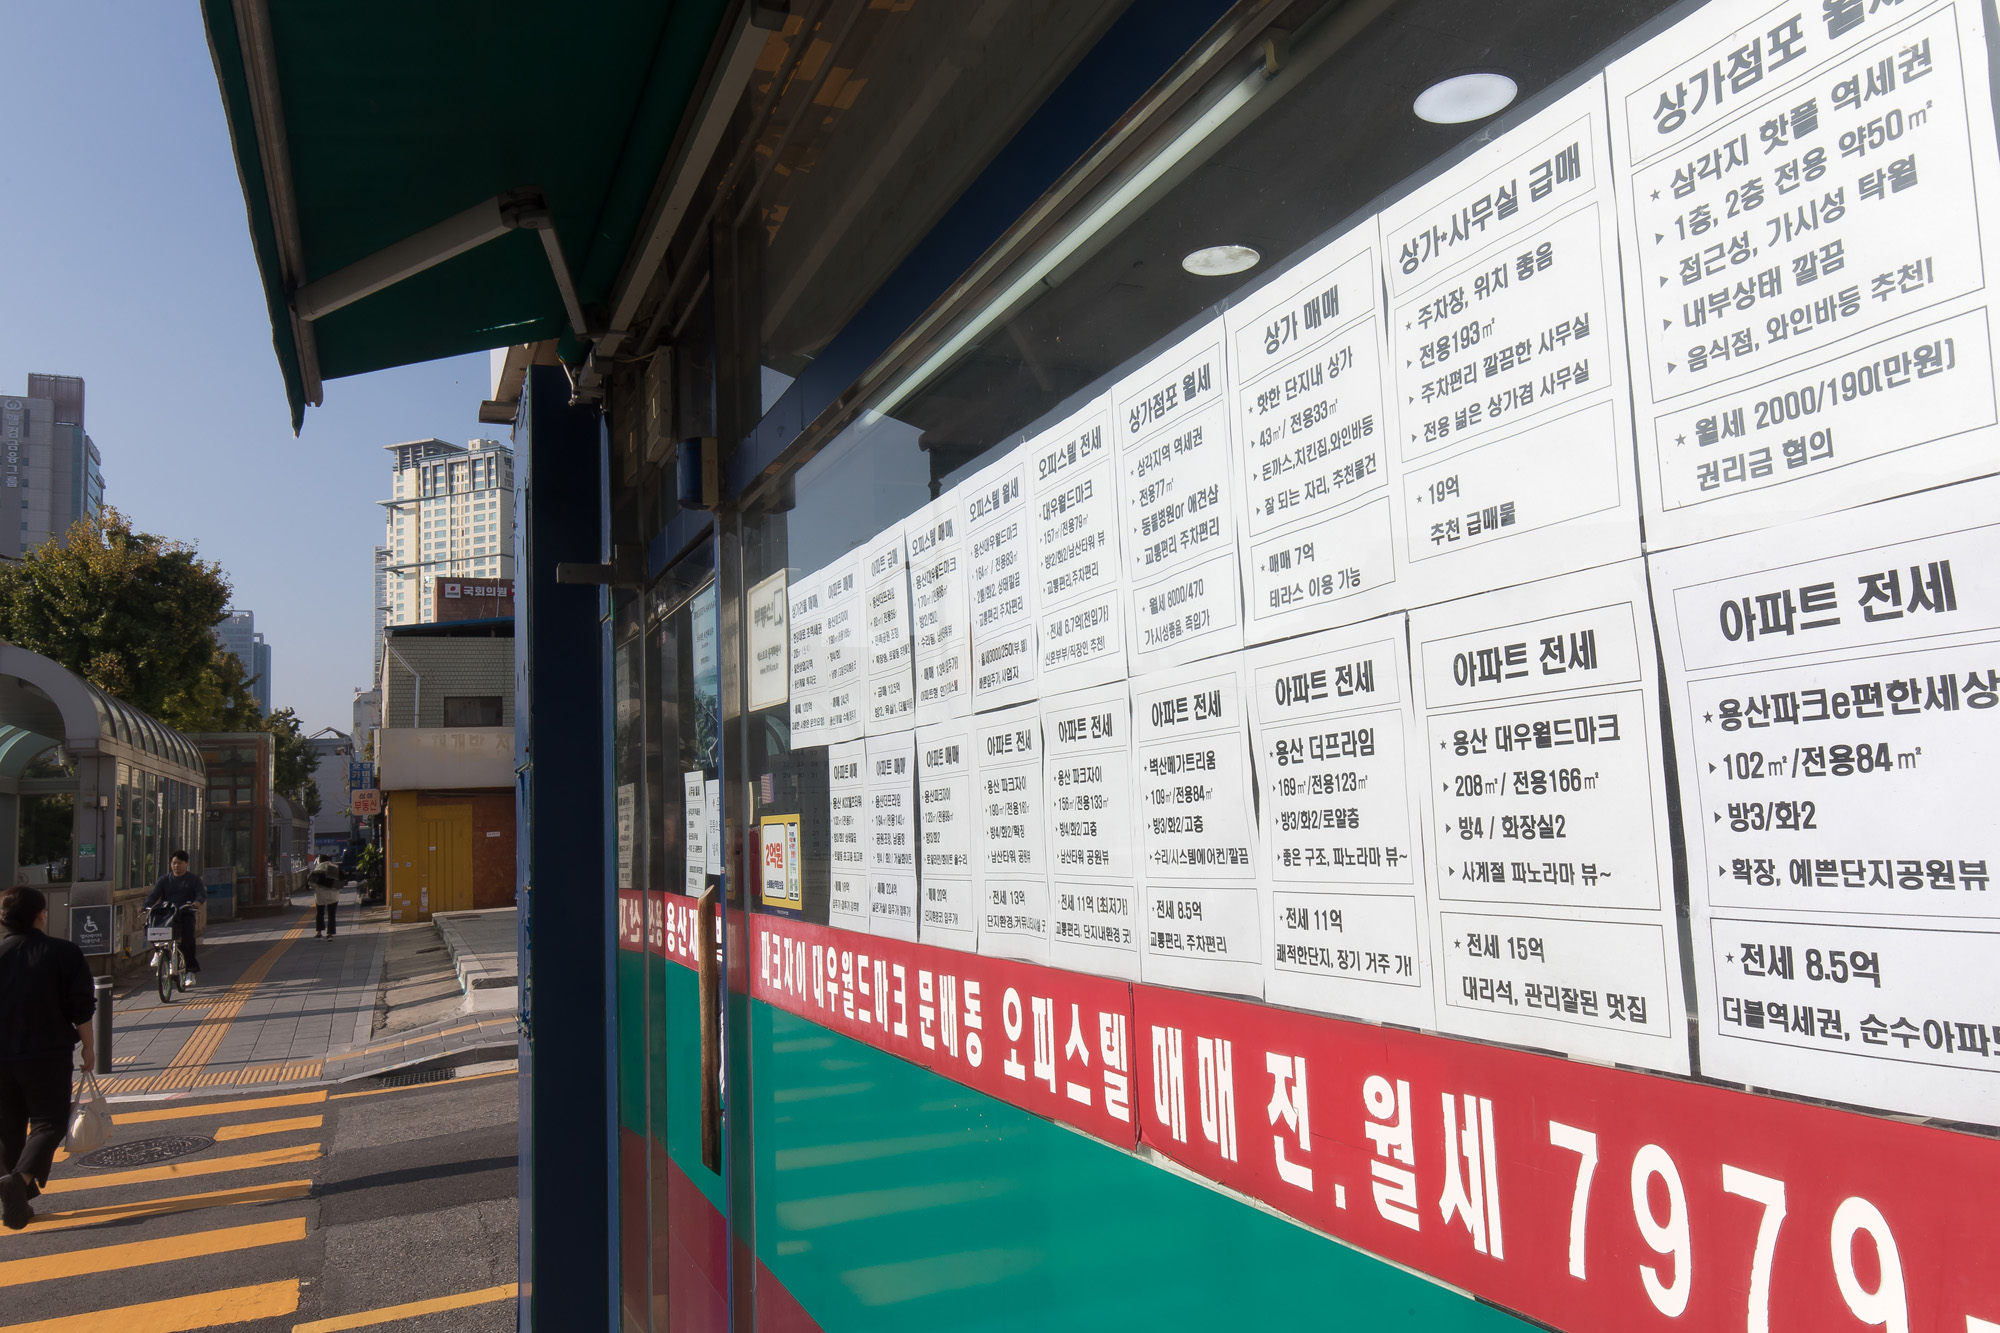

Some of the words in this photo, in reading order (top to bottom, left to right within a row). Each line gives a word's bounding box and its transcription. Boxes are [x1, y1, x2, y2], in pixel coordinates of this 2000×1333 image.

[1652, 12, 1806, 134] 상가점포
[1822, 0, 1904, 40] 월
[1670, 132, 1749, 200] 삼각지
[1759, 97, 1818, 155] 핫플
[1831, 37, 1932, 111] 역세권
[1528, 141, 1581, 202] 급매
[1674, 202, 1718, 241] 1층,
[1725, 176, 1764, 219] 2층
[1774, 146, 1827, 196] 전용
[1679, 230, 1758, 286] 접근성,
[1766, 186, 1846, 248] 가시성
[1858, 153, 1918, 201] 탁월
[1417, 286, 1468, 330] 주차장,
[1474, 262, 1508, 301] 위치
[1516, 241, 1553, 281] 좋음
[1682, 265, 1782, 327] 내부상태
[1792, 238, 1845, 286] 깔끔
[1263, 310, 1298, 355] 상가
[1303, 284, 1339, 330] 매매
[1687, 326, 1760, 373] 음식점,
[1766, 284, 1861, 344] 와인바등
[1871, 256, 1933, 302] 추천!
[1421, 361, 1477, 404] 주차편리
[1482, 338, 1532, 378] 깔끔한
[1538, 312, 1590, 355] 사무실
[1128, 382, 1178, 434] 상가점포
[1182, 362, 1211, 402] 월세
[1257, 384, 1281, 416] 핫한
[1284, 362, 1323, 401] 단지내
[1327, 345, 1353, 379] 상가
[1423, 415, 1450, 443] 전용
[1454, 402, 1482, 431] 넓은
[1487, 380, 1534, 418] 상가겸
[1539, 358, 1589, 397] 사무실
[1695, 407, 1746, 447] 월세
[1038, 439, 1077, 481] 오피스텔
[1079, 424, 1102, 458] 전세
[1136, 442, 1171, 478] 삼각지역
[1173, 425, 1203, 455] 역세권
[1696, 446, 1773, 492] 권리금
[1782, 427, 1834, 470] 협의
[969, 488, 1000, 523] 오피스텔
[1002, 476, 1019, 505] 월세
[1042, 479, 1093, 521] 대우월드마크
[1264, 495, 1275, 516] 잘
[1277, 488, 1300, 510] 되는
[1304, 475, 1330, 500] 자리,
[1332, 452, 1376, 489] 추천물건
[1428, 474, 1460, 505] 19억
[1141, 502, 1184, 536] 동물병원or
[1187, 483, 1219, 513] 애견샵
[1430, 517, 1460, 546] 추천
[1466, 501, 1515, 536] 급매물
[1097, 530, 1105, 546] 뷰
[1144, 534, 1177, 565] 교통편리
[1179, 516, 1220, 549] 주차편리
[1268, 549, 1291, 573] 매매
[1294, 542, 1314, 565] 7억
[463, 586, 508, 597] 국회의원
[1149, 593, 1166, 615] 월세
[1167, 578, 1204, 608] 8000/470
[1269, 582, 1304, 608] 테라스
[1308, 574, 1333, 597] 이용
[1337, 566, 1361, 590] 가능
[1719, 581, 1840, 642] 아파트
[1857, 559, 1957, 623] 전세
[1049, 620, 1062, 640] 전세
[1453, 642, 1529, 687] 아파트
[1539, 629, 1598, 676] 전세
[1275, 669, 1328, 706] 아파트
[1334, 659, 1375, 697] 전세
[1718, 669, 2000, 732] 용산파크e편한세상
[1058, 717, 1087, 743] 아파트
[1090, 712, 1113, 739] 전세
[1151, 696, 1189, 728] 아파트
[1193, 689, 1222, 721] 전세
[986, 733, 1013, 756] 아파트
[1015, 728, 1032, 752] 전세
[1275, 737, 1304, 766] 용산
[1308, 727, 1375, 761] 더프라임
[1453, 727, 1488, 756] 용산
[1494, 713, 1620, 752] 대우월드마크
[1057, 768, 1071, 786] 용산
[1072, 765, 1102, 784] 파크자이
[1149, 750, 1216, 776] 벽산메가트리움
[354, 800, 377, 812] 부동산
[1152, 814, 1204, 835] 방3/화2/고층
[1280, 807, 1359, 831] 방3/화2/로얄층
[1458, 816, 1484, 840] 방4
[1501, 814, 1566, 840] 화장실2
[1727, 800, 1817, 832] 방3/화2
[766, 842, 783, 869] 2억원
[1060, 849, 1084, 864] 남산타워
[1086, 849, 1109, 865] 공원뷰
[1154, 847, 1249, 865] 수리/시스템에어컨/깔끔
[1282, 847, 1301, 867] 좋은
[1304, 848, 1330, 867] 구조,
[1332, 846, 1381, 867] 파노라마
[1461, 861, 1506, 883] 사계절
[1510, 861, 1575, 885] 파노라마
[1731, 858, 1781, 886] 확장,
[1789, 858, 1990, 891] 예쁜단지공원뷰
[1060, 893, 1075, 911] 전세
[1076, 895, 1094, 913] 11억
[1156, 899, 1174, 919] 전세
[1177, 901, 1202, 921] 8.5억
[1285, 907, 1309, 930] 전세
[1313, 909, 1343, 933] 11억
[1083, 924, 1120, 943] 단지내환경
[1150, 931, 1184, 950] 교통편리,
[1186, 934, 1227, 953] 주차편리
[1466, 932, 1500, 959] 전세
[1507, 936, 1545, 963] 15억
[1276, 943, 1334, 968] 쾌적한단지,
[1336, 949, 1360, 971] 장기
[1364, 952, 1390, 974] 거주
[1394, 954, 1412, 977] 가!
[1740, 942, 1794, 980] 전세
[1805, 948, 1881, 988] 8.5억
[1462, 976, 1518, 1006] 대리석,
[1524, 982, 1598, 1017] 관리잘된
[1605, 992, 1647, 1024] 멋집
[1722, 996, 1850, 1042] 더블역세권,
[761, 930, 807, 1002] 파크자이
[812, 946, 908, 1038] 대우월드마크
[919, 970, 983, 1068] 문배동
[1003, 986, 1130, 1122] 오피스텔
[1151, 1024, 1238, 1162] 매매
